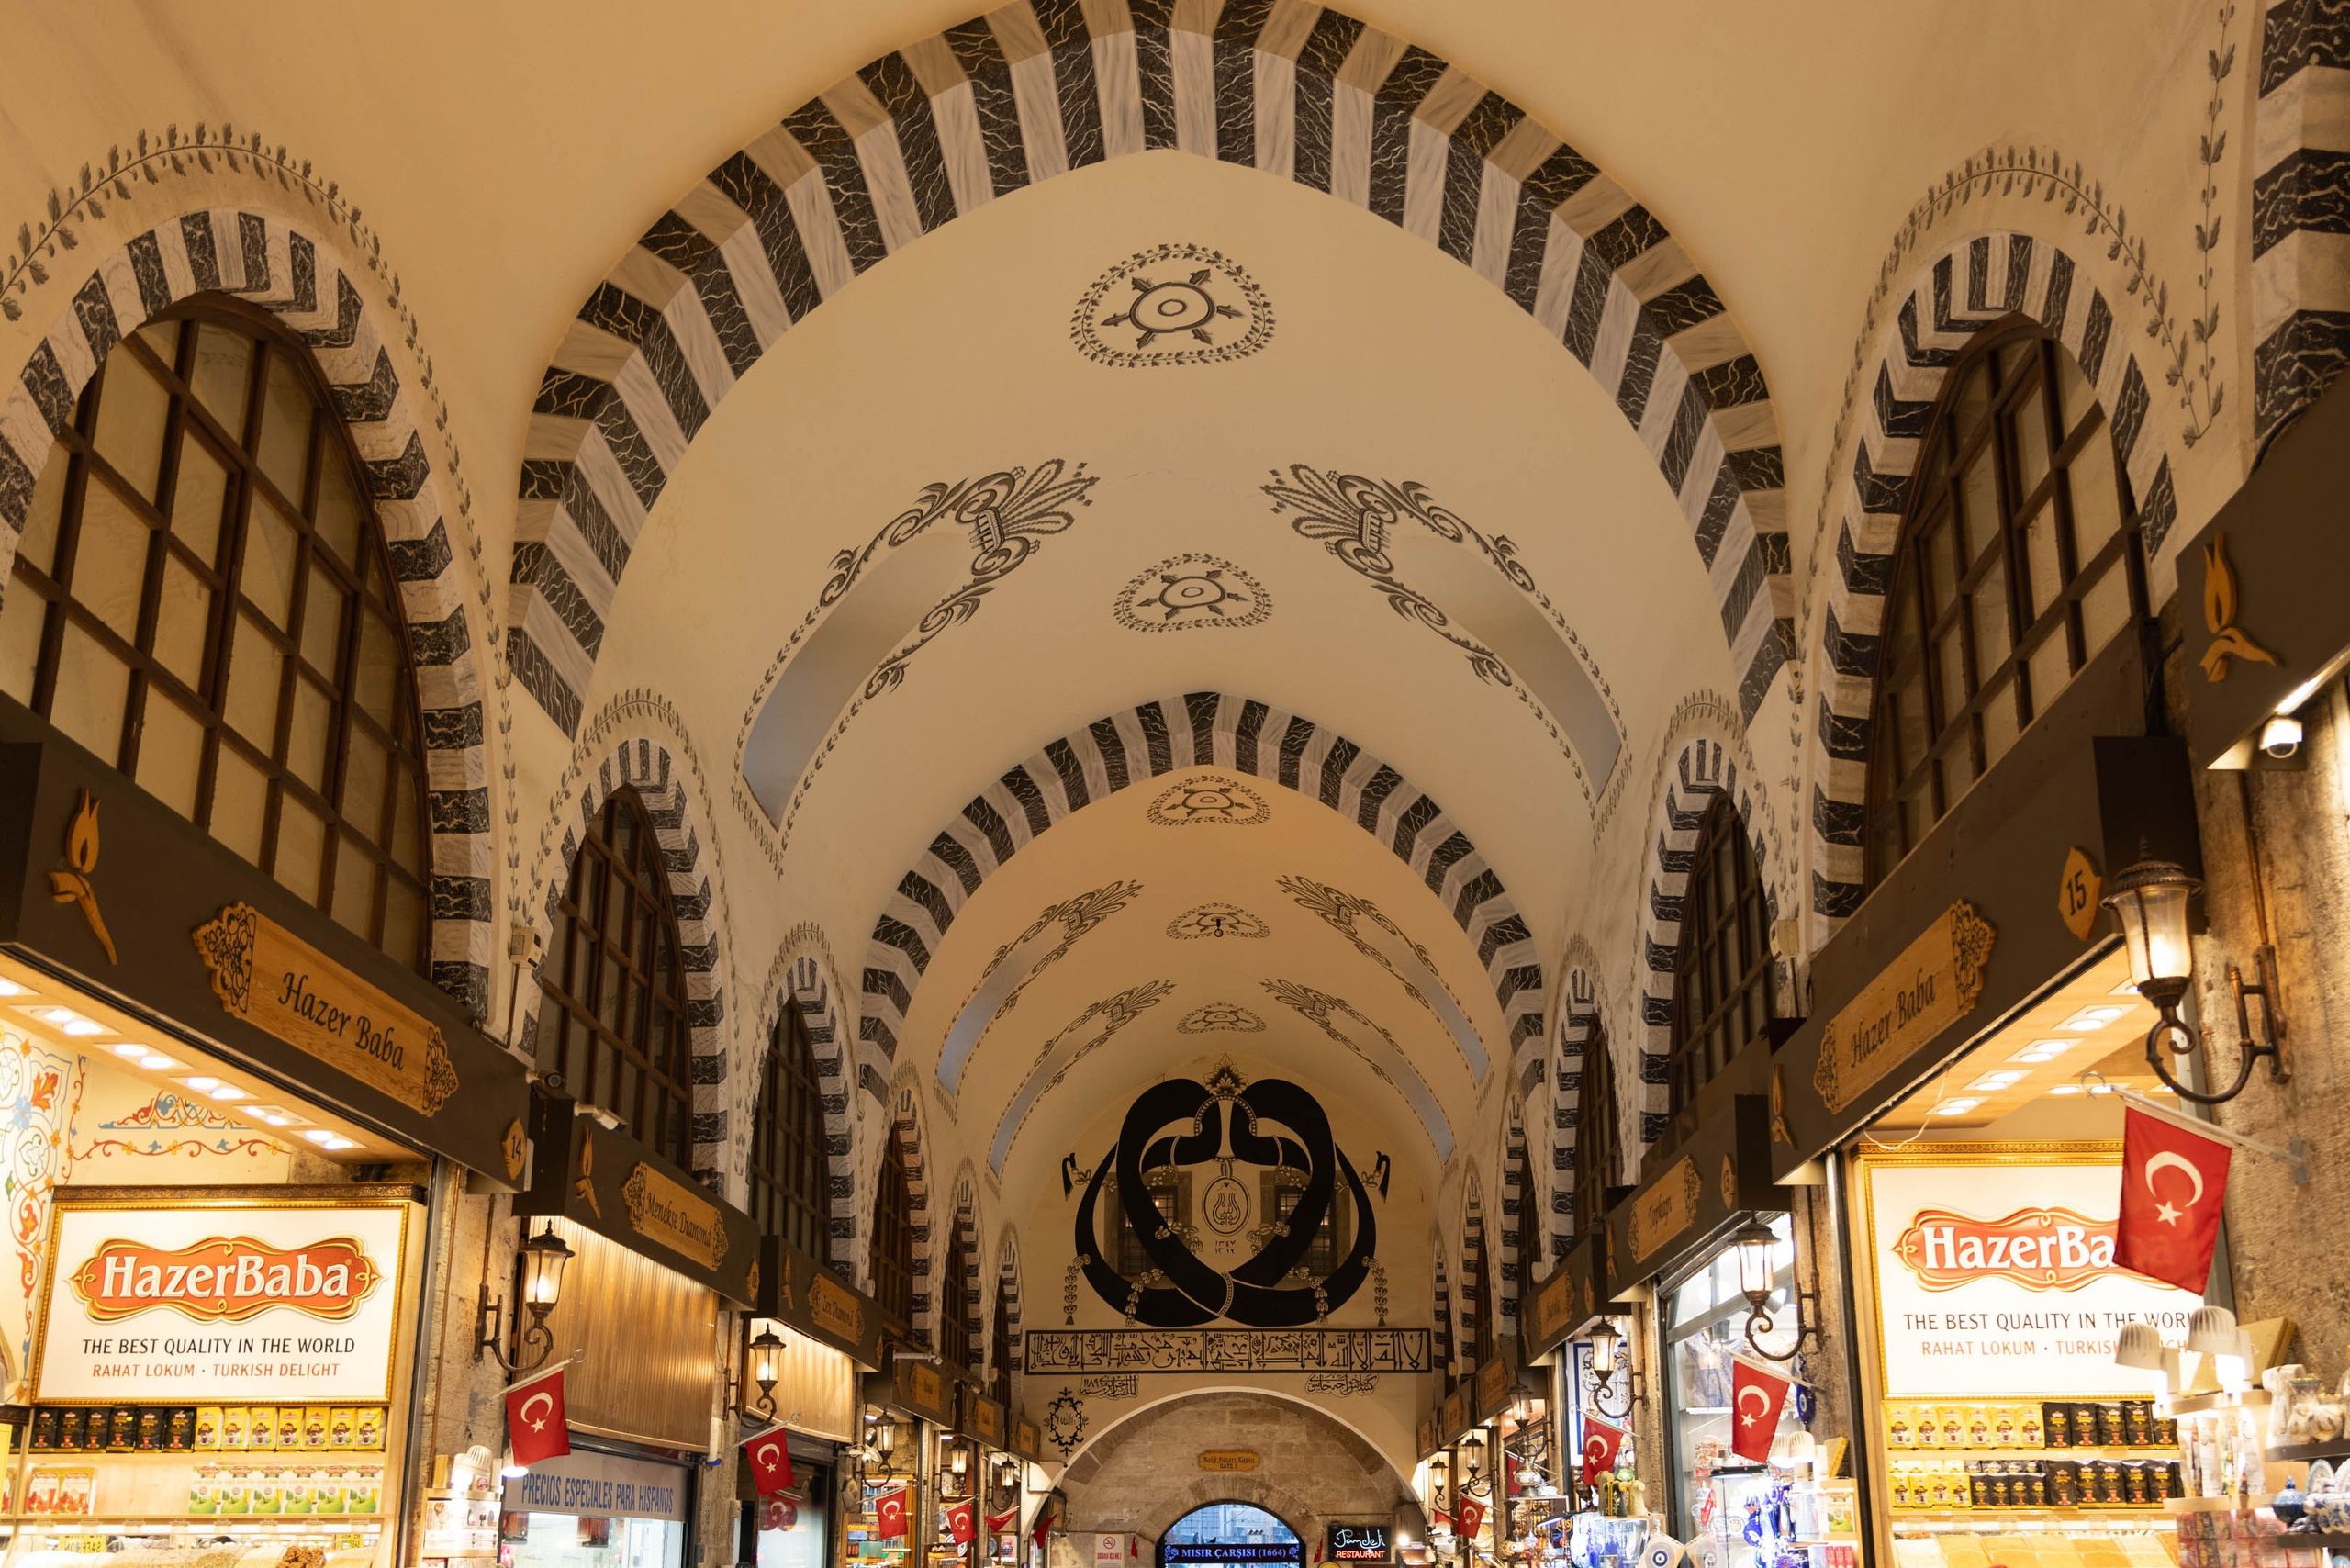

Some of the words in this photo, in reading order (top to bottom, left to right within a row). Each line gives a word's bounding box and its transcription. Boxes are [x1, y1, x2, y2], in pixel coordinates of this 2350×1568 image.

[2067, 869, 2087, 916] 15
[278, 972, 352, 1037] Hazer
[355, 1015, 404, 1070] Baba
[1851, 1020, 1892, 1069] Hazer
[1896, 967, 1935, 1030] Baba
[511, 1135, 522, 1162] 14
[679, 1211, 712, 1249] Diamond
[100, 1253, 349, 1298] HazerBaba
[1904, 1313, 1937, 1330] THE
[1946, 1313, 1989, 1330] BEST
[1997, 1312, 2071, 1332] QUALITY
[2078, 1312, 2097, 1329] IN
[82, 1338, 112, 1354] THE
[118, 1338, 158, 1354] BEST
[164, 1338, 231, 1356] QUALITY
[237, 1338, 254, 1354] IN
[261, 1338, 291, 1354] THE
[297, 1338, 355, 1354] WORLD
[1922, 1340, 1974, 1356] RAHAT
[1981, 1340, 2036, 1356] LOKUM
[93, 1363, 140, 1378] RAHAT
[145, 1362, 195, 1377] LOKUM
[213, 1362, 274, 1377] TURKISH
[279, 1362, 340, 1377] DELIGHT
[521, 1473, 562, 1506] PRECIOS
[565, 1477, 613, 1509] ESPECIALES
[616, 1483, 635, 1511] PARA
[638, 1484, 674, 1514] HISPANOS
[1181, 1549, 1213, 1558] MISIR
[1214, 1549, 1257, 1559] ÇARŞISI
[1258, 1549, 1287, 1558] (1664)
[1335, 1551, 1385, 1559] RESTAURANT
